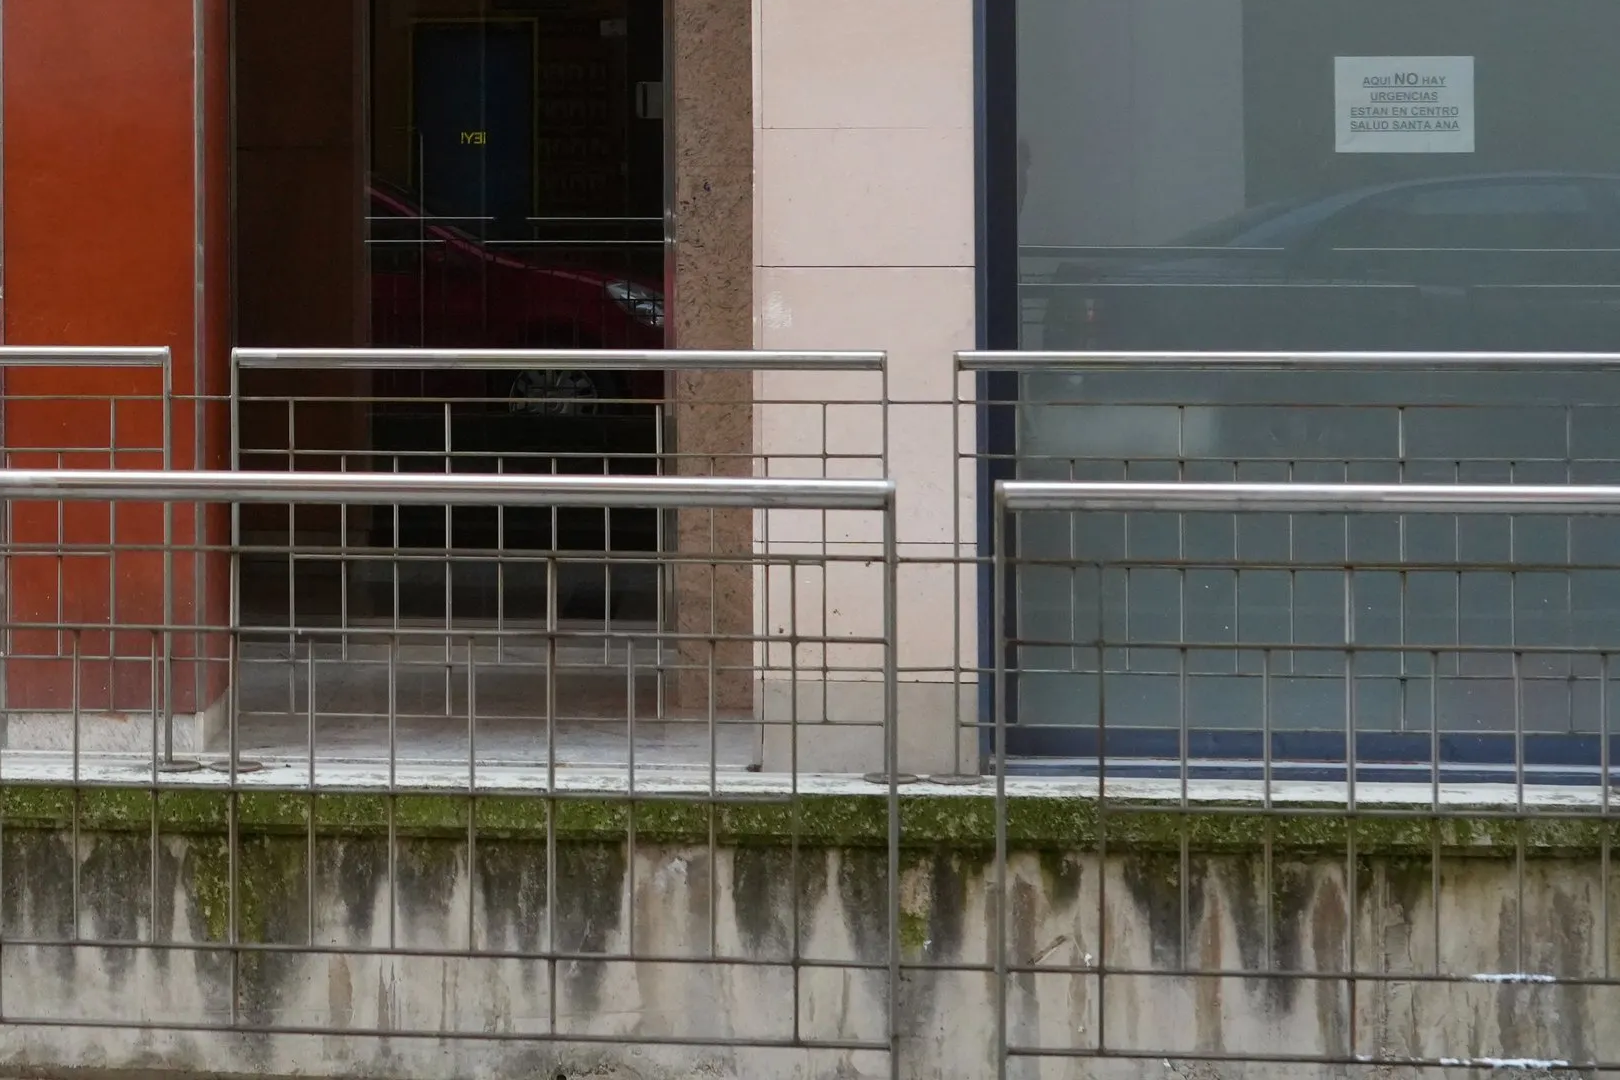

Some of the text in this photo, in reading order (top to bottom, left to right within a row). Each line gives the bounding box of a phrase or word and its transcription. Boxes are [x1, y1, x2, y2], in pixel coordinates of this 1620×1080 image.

[1394, 73, 1419, 85] NO
[1422, 76, 1446, 85] HAY
[1370, 91, 1438, 101] URGENCIAS
[1350, 107, 1459, 116] ESTAN EN CENTRO
[1350, 121, 1459, 130] SALUD SANTA ANA
